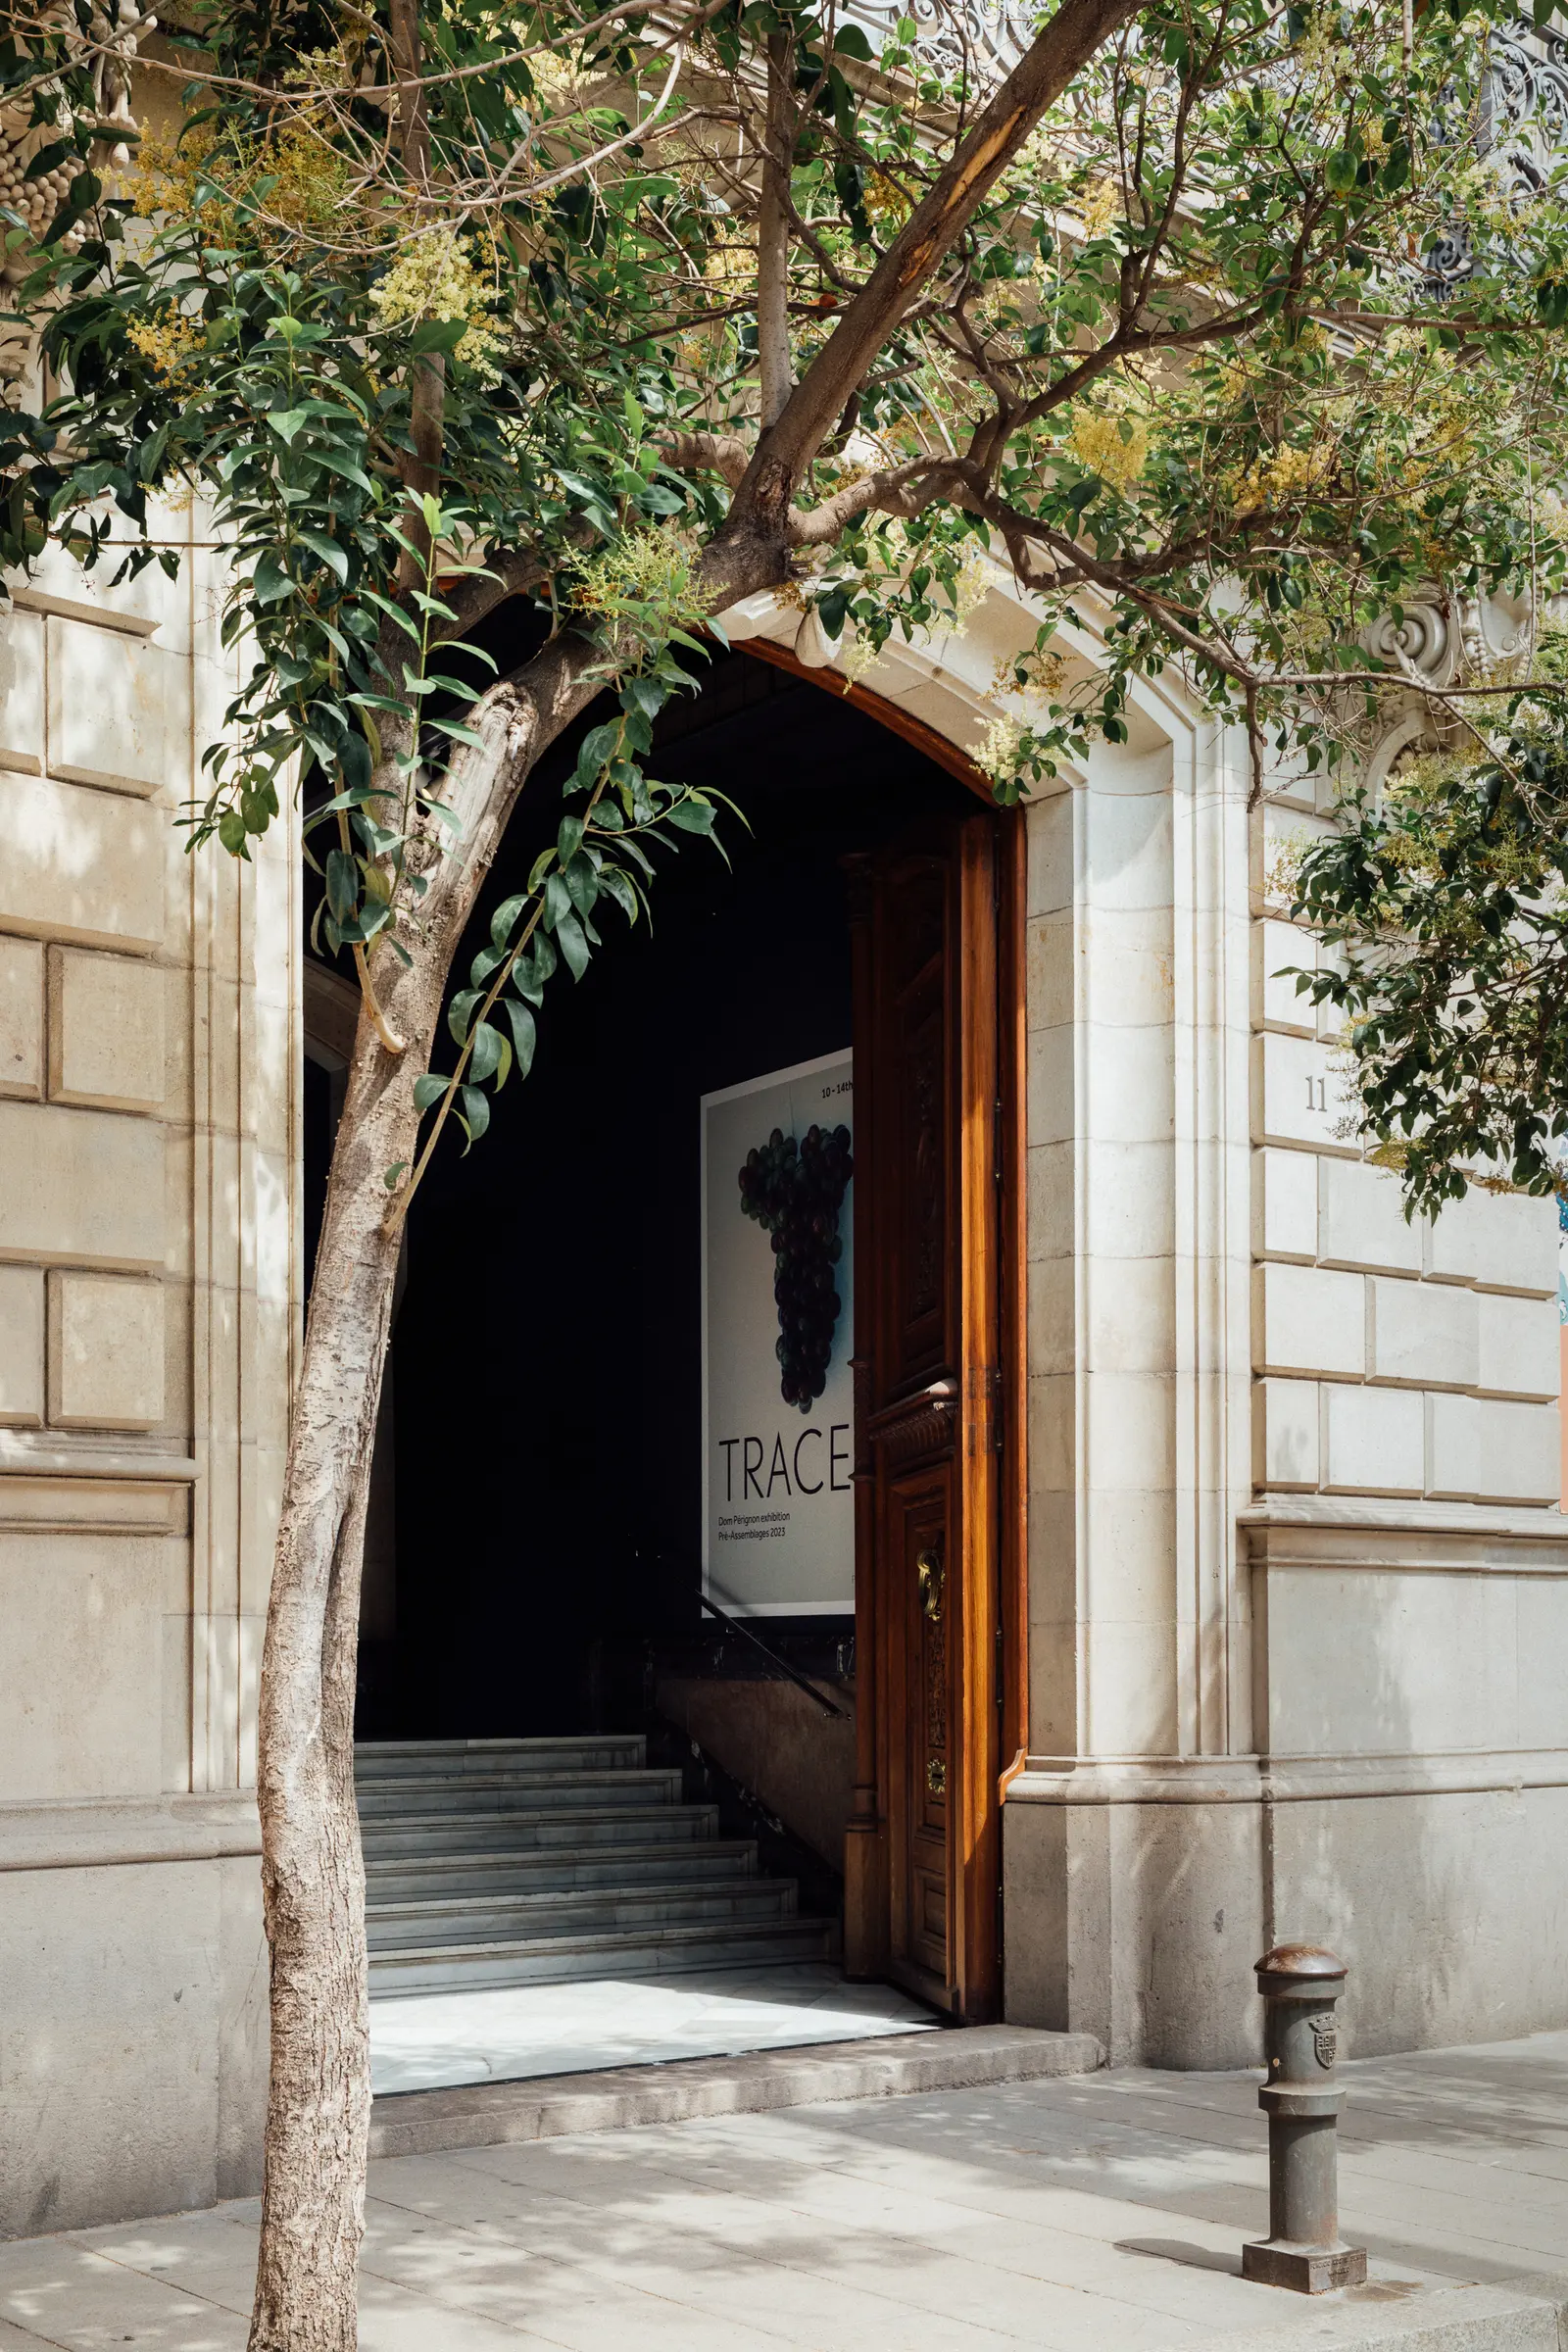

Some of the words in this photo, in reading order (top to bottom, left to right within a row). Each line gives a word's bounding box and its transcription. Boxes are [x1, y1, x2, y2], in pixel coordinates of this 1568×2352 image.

[821, 1086, 831, 1099] 10
[836, 1080, 855, 1095] 14th
[1305, 1075, 1328, 1112] 11
[718, 1424, 851, 1501] TRACE
[718, 1516, 733, 1526] Dom
[733, 1514, 760, 1527] Pérignon
[760, 1511, 790, 1523] exhibition
[718, 1530, 769, 1541] Pré-Assemblages
[770, 1527, 786, 1538] 2023
